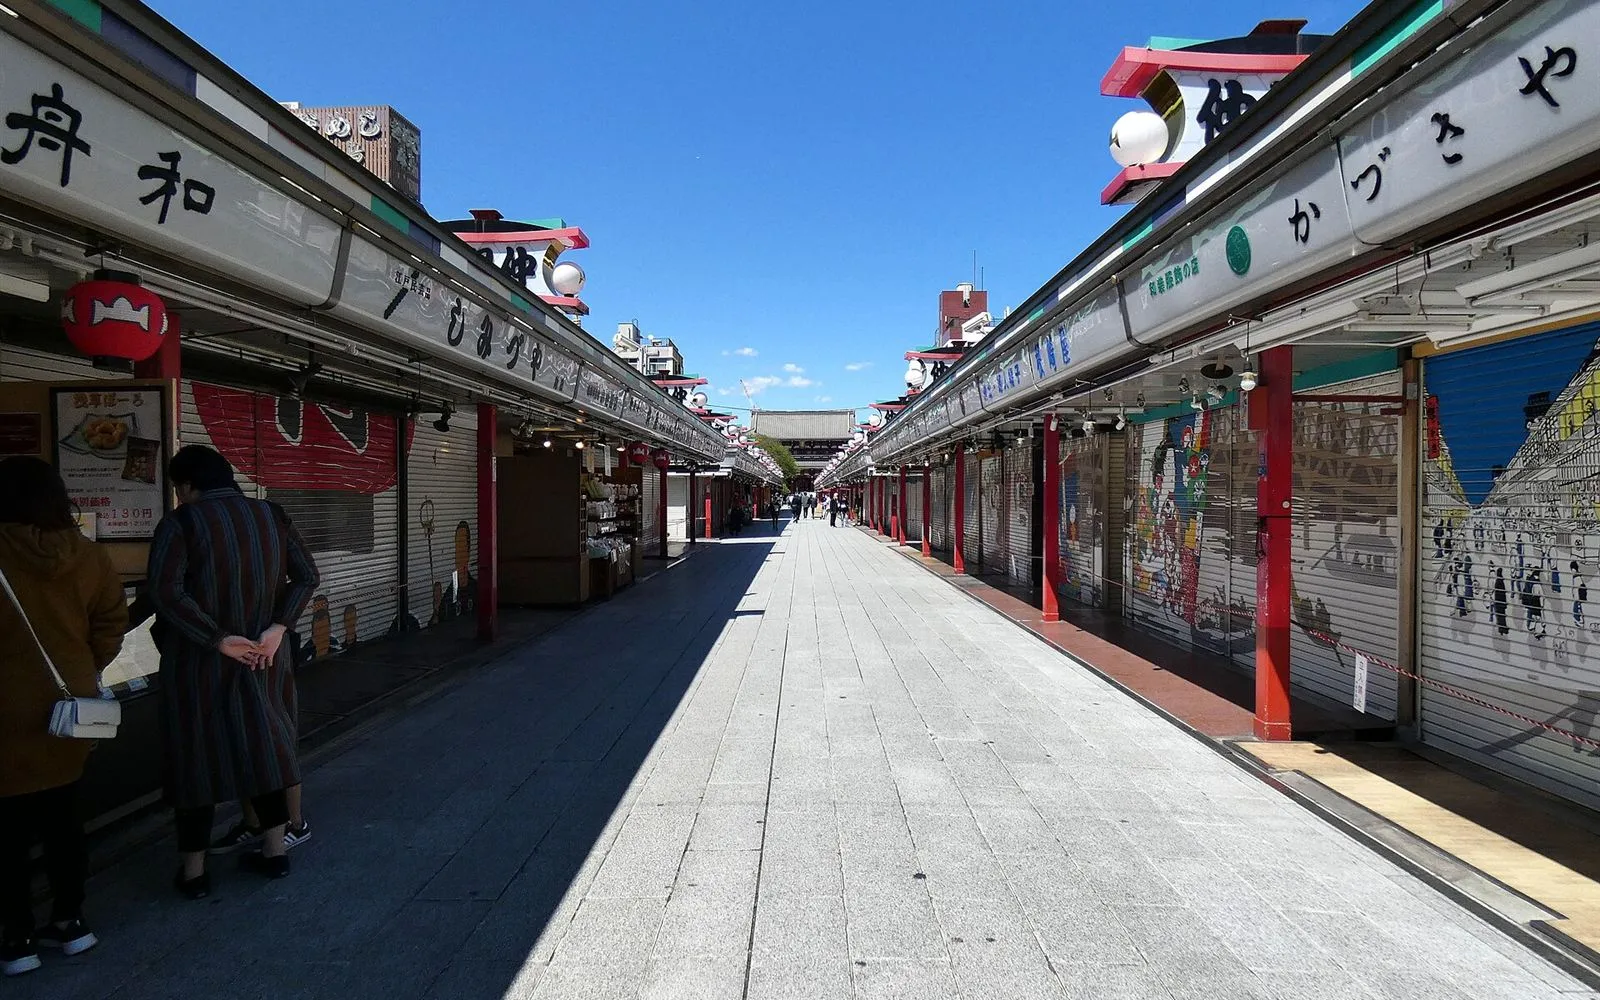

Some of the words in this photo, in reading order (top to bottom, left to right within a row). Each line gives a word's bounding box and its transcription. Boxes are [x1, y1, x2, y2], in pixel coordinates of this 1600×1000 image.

[1, 83, 216, 225] 舟和
[1196, 77, 1281, 145] 仲
[1287, 45, 1577, 245] かづきや
